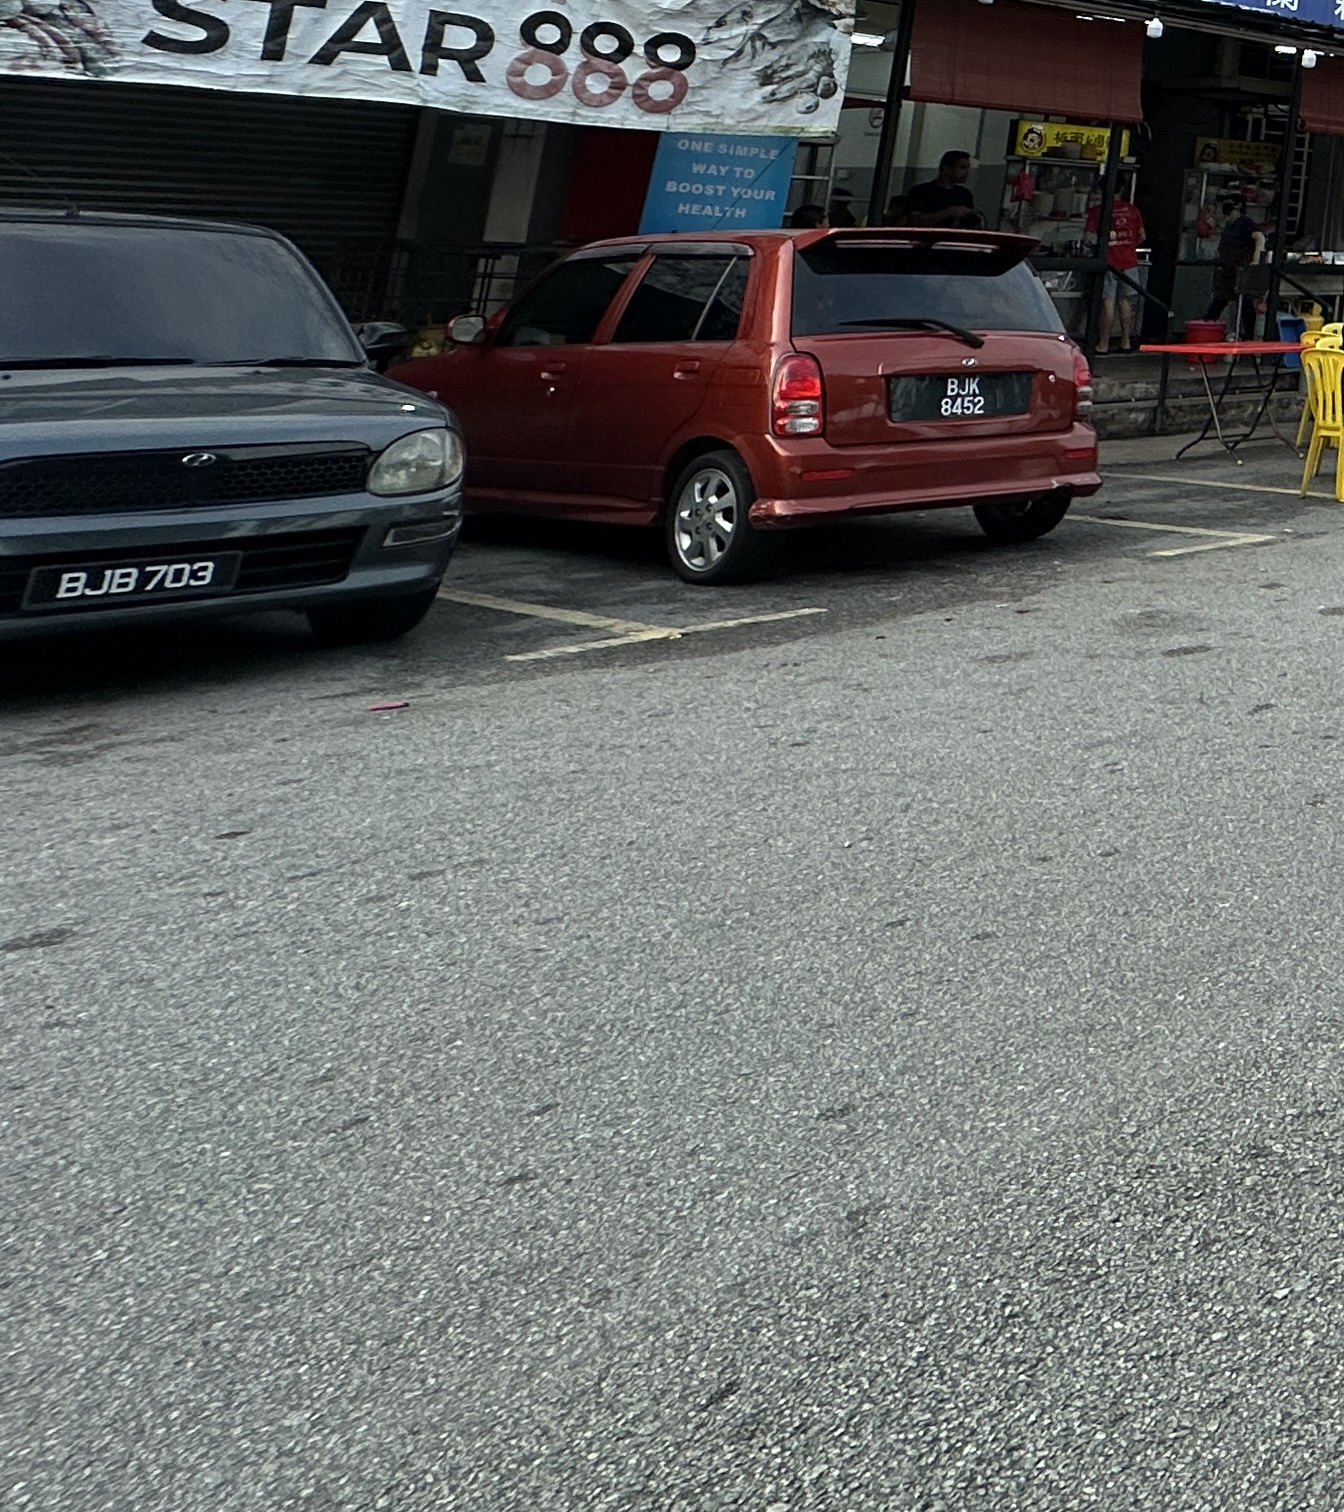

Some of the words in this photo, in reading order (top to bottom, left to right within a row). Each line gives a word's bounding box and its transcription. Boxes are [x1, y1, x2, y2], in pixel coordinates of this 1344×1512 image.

[677, 139, 714, 154] ONE
[717, 143, 780, 160] SIMPLE
[692, 162, 730, 177] WAY
[734, 167, 756, 179] TO
[665, 180, 727, 197] BOOST
[731, 187, 776, 201] YOUR
[677, 203, 748, 219] HEALTH
[947, 377, 980, 396] BJK
[941, 396, 985, 416] 8452
[56, 567, 139, 598] BJB
[144, 561, 215, 590] 703
